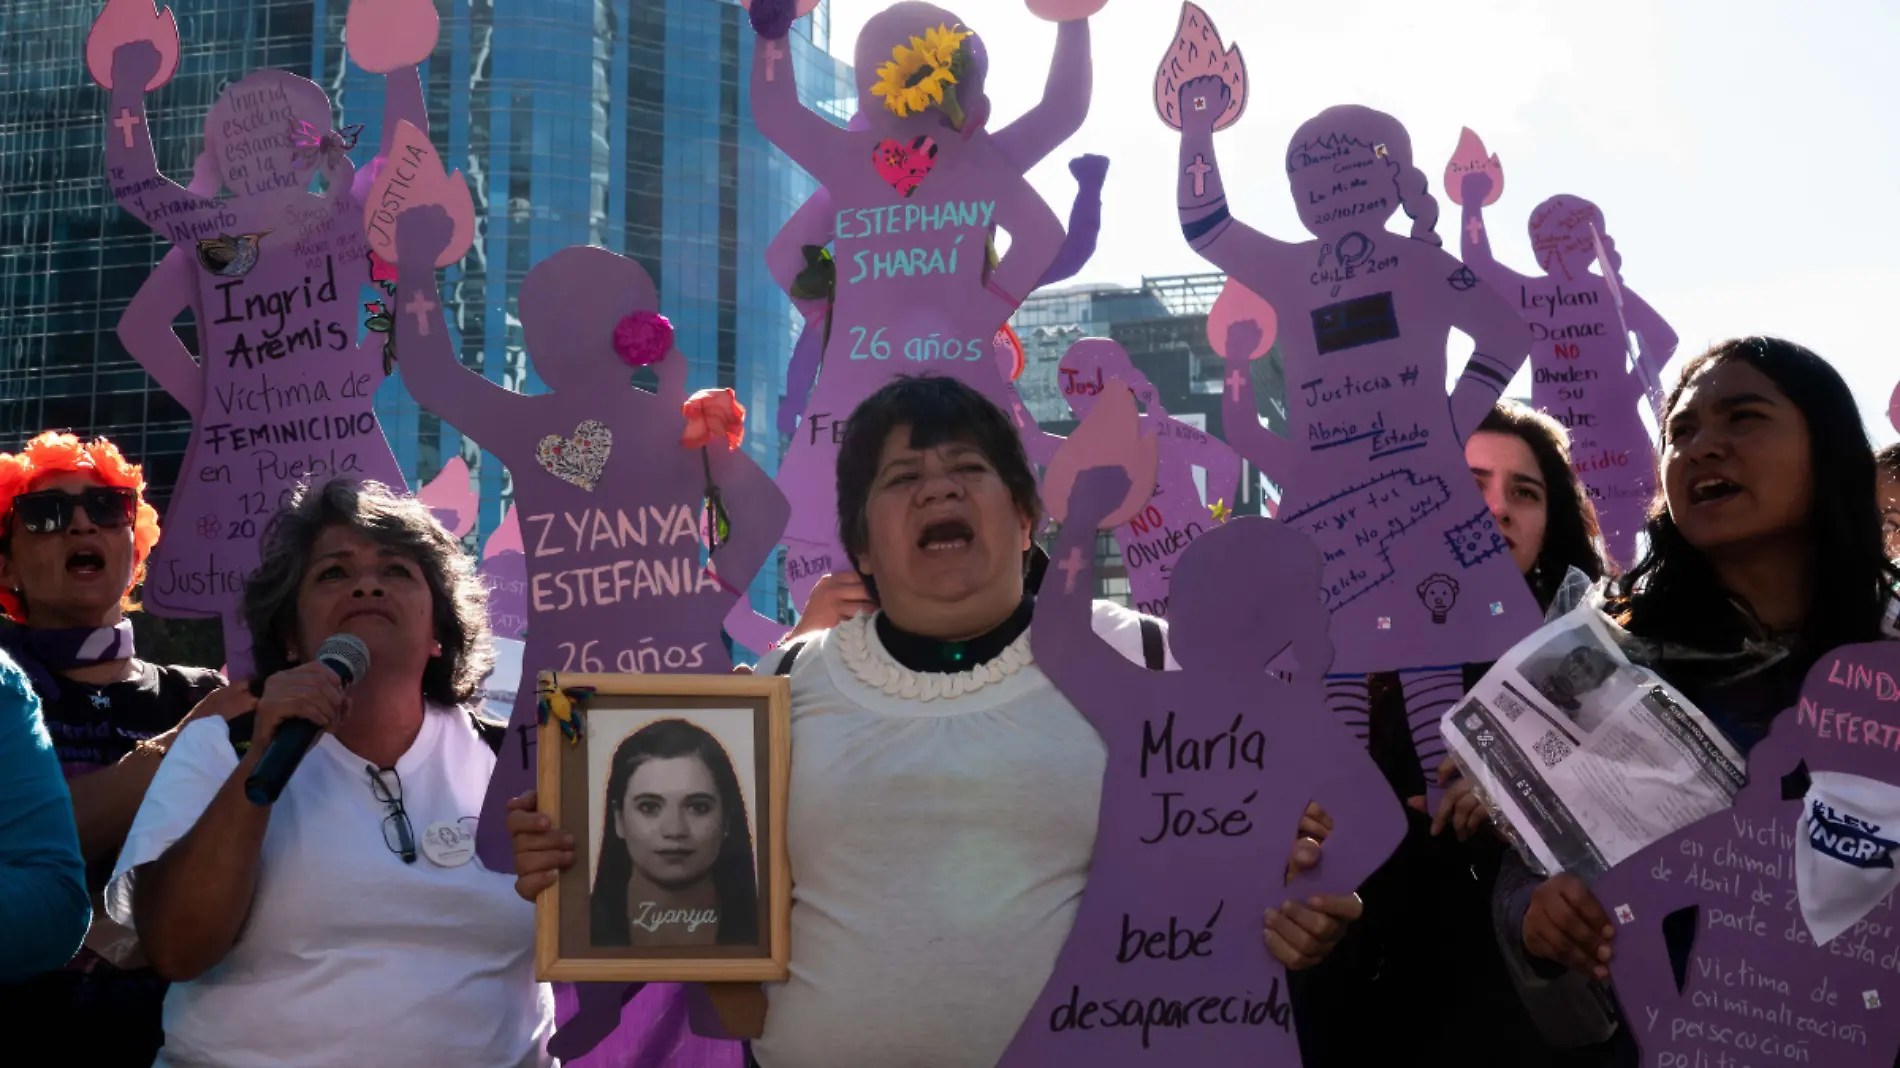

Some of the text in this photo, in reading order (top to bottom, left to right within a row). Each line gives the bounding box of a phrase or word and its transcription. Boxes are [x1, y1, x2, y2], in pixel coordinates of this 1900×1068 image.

[835, 200, 996, 239] ESTEPHANY
[213, 254, 338, 338] Ingrid
[1520, 283, 1600, 320] Leylani
[849, 326, 984, 362] 26 años
[1553, 343, 1582, 361] NO
[340, 371, 371, 399] de
[1301, 377, 1391, 408] Justicia
[204, 411, 375, 454] FEMINICIDIO
[808, 412, 850, 447] FE
[1371, 427, 1430, 451] Estado
[199, 449, 363, 486] en Puebla
[527, 504, 700, 557] ZYANYA
[1130, 506, 1163, 538] NO
[1126, 521, 1204, 569] Olviden
[158, 552, 247, 596] Justici
[531, 557, 722, 612] ESTEFANIA
[557, 637, 709, 674] 26 años
[1827, 657, 1900, 703] LIND
[1139, 710, 1266, 779] María
[1138, 789, 1259, 845] José
[1679, 839, 1704, 859] en
[1650, 856, 1674, 882] de
[1683, 861, 1741, 899] Abril
[1750, 877, 1774, 907] de
[1853, 918, 1894, 940] por
[632, 901, 719, 933] Zyanya
[1115, 899, 1224, 964] bebé
[1707, 904, 1768, 938] parte
[1810, 975, 1839, 1007] de
[1049, 975, 1292, 1050] desaparecida
